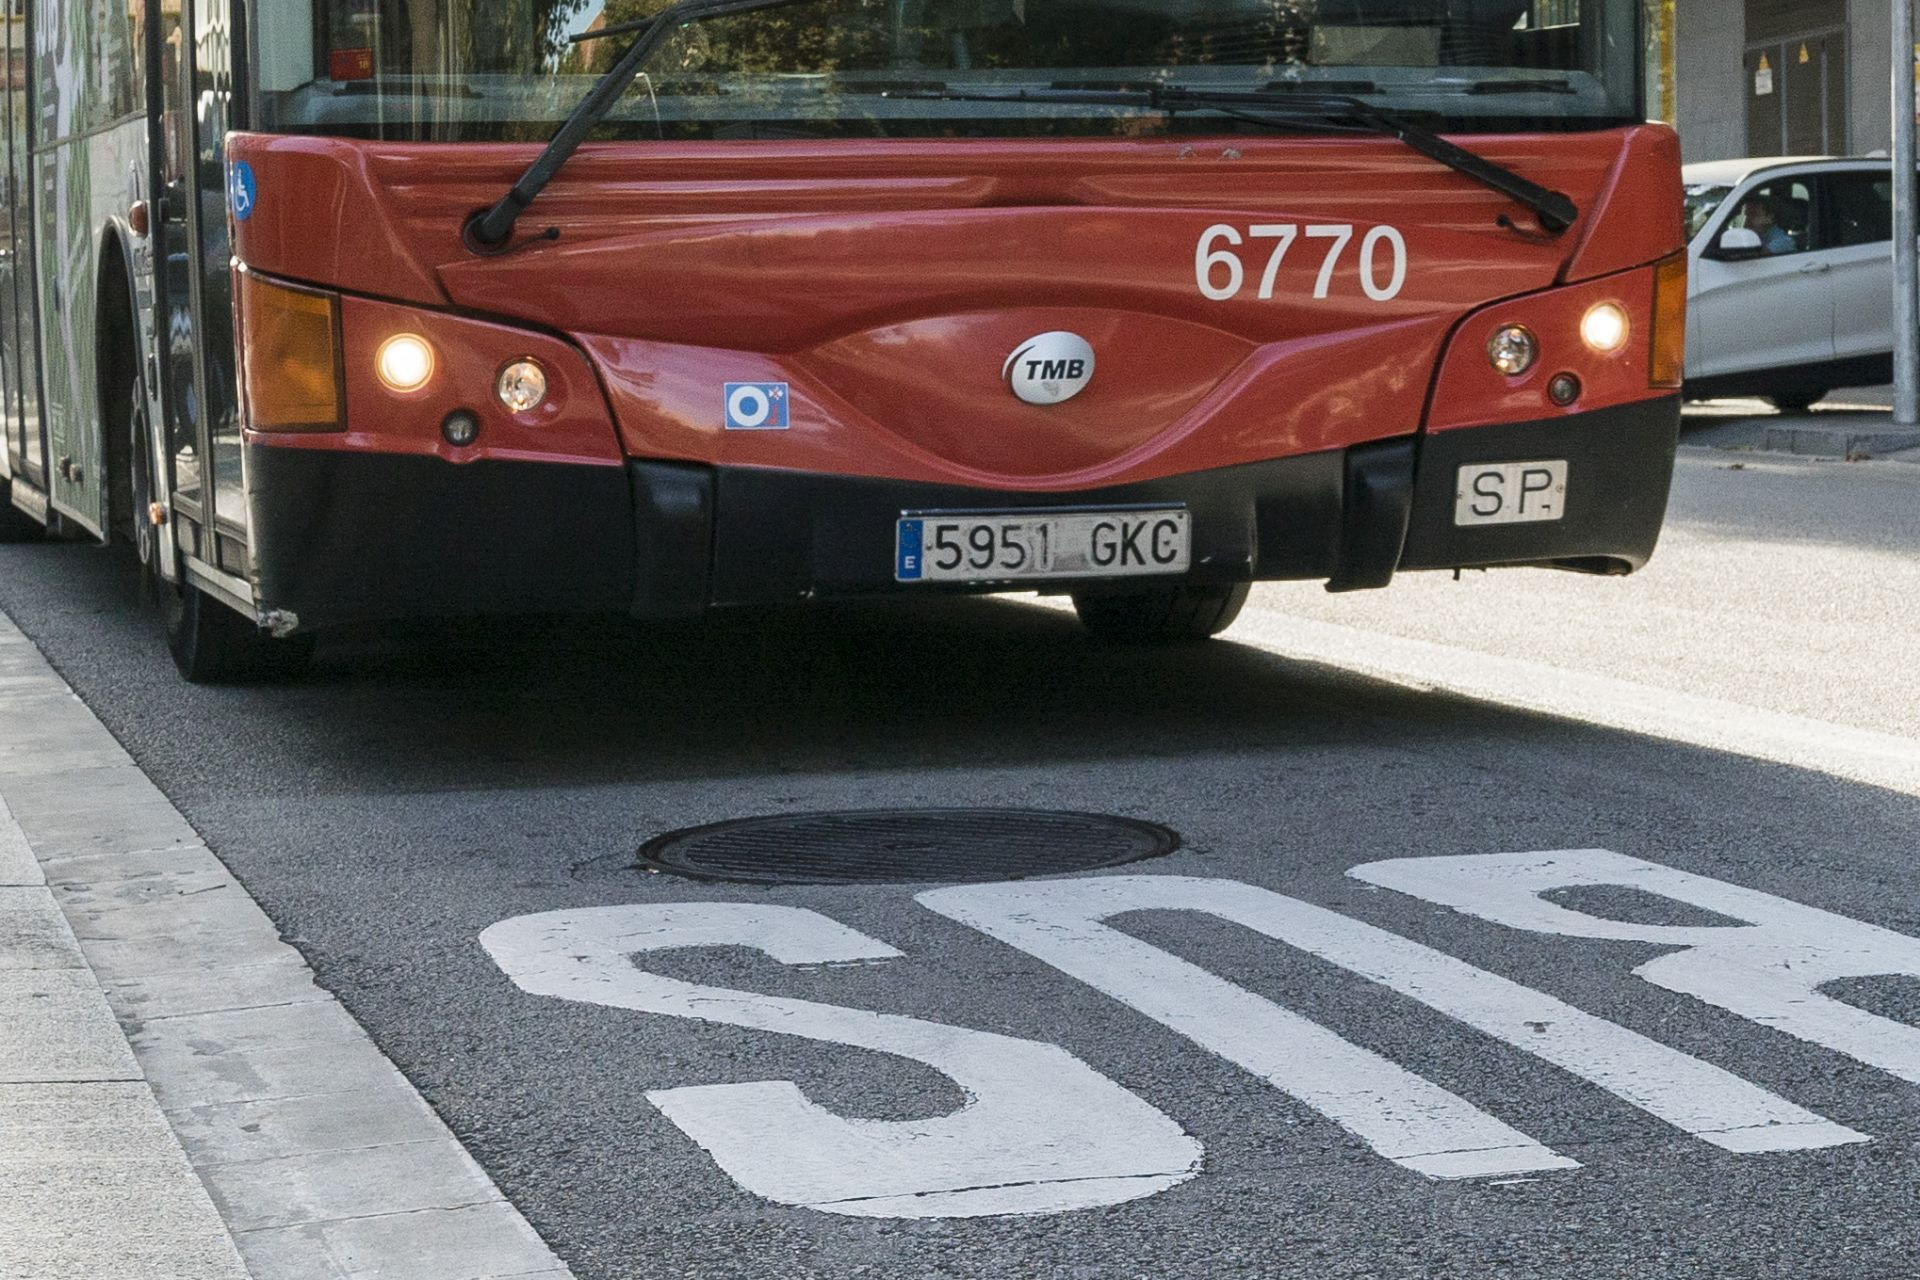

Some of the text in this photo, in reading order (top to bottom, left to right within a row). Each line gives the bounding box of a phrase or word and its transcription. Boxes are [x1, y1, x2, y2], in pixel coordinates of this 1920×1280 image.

[1195, 223, 1407, 301] 6770
[1026, 359, 1085, 380] TMB
[904, 519, 1179, 570] E 5951 GKC
[478, 848, 1920, 1220] BUS
